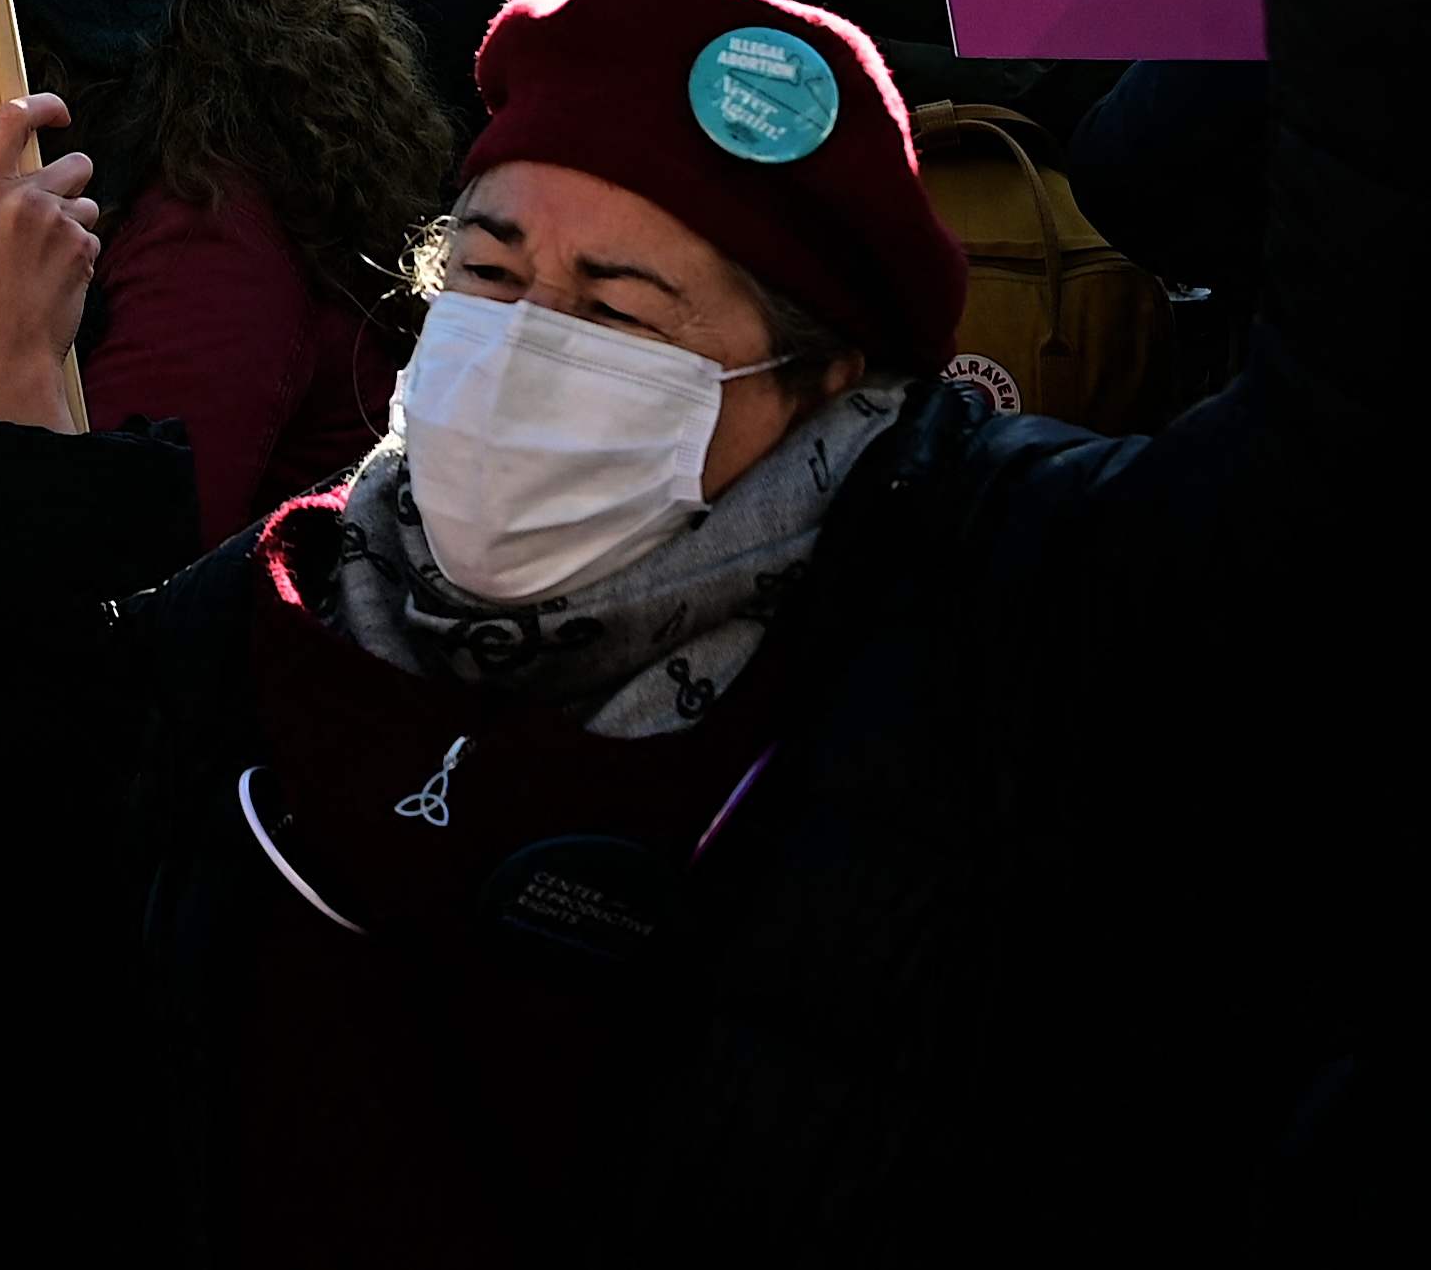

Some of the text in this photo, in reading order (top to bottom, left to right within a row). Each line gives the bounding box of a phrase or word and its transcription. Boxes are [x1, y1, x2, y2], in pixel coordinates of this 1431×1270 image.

[729, 37, 785, 60] ILLEGAL
[718, 50, 797, 78] ABORTION
[723, 74, 778, 115] Never
